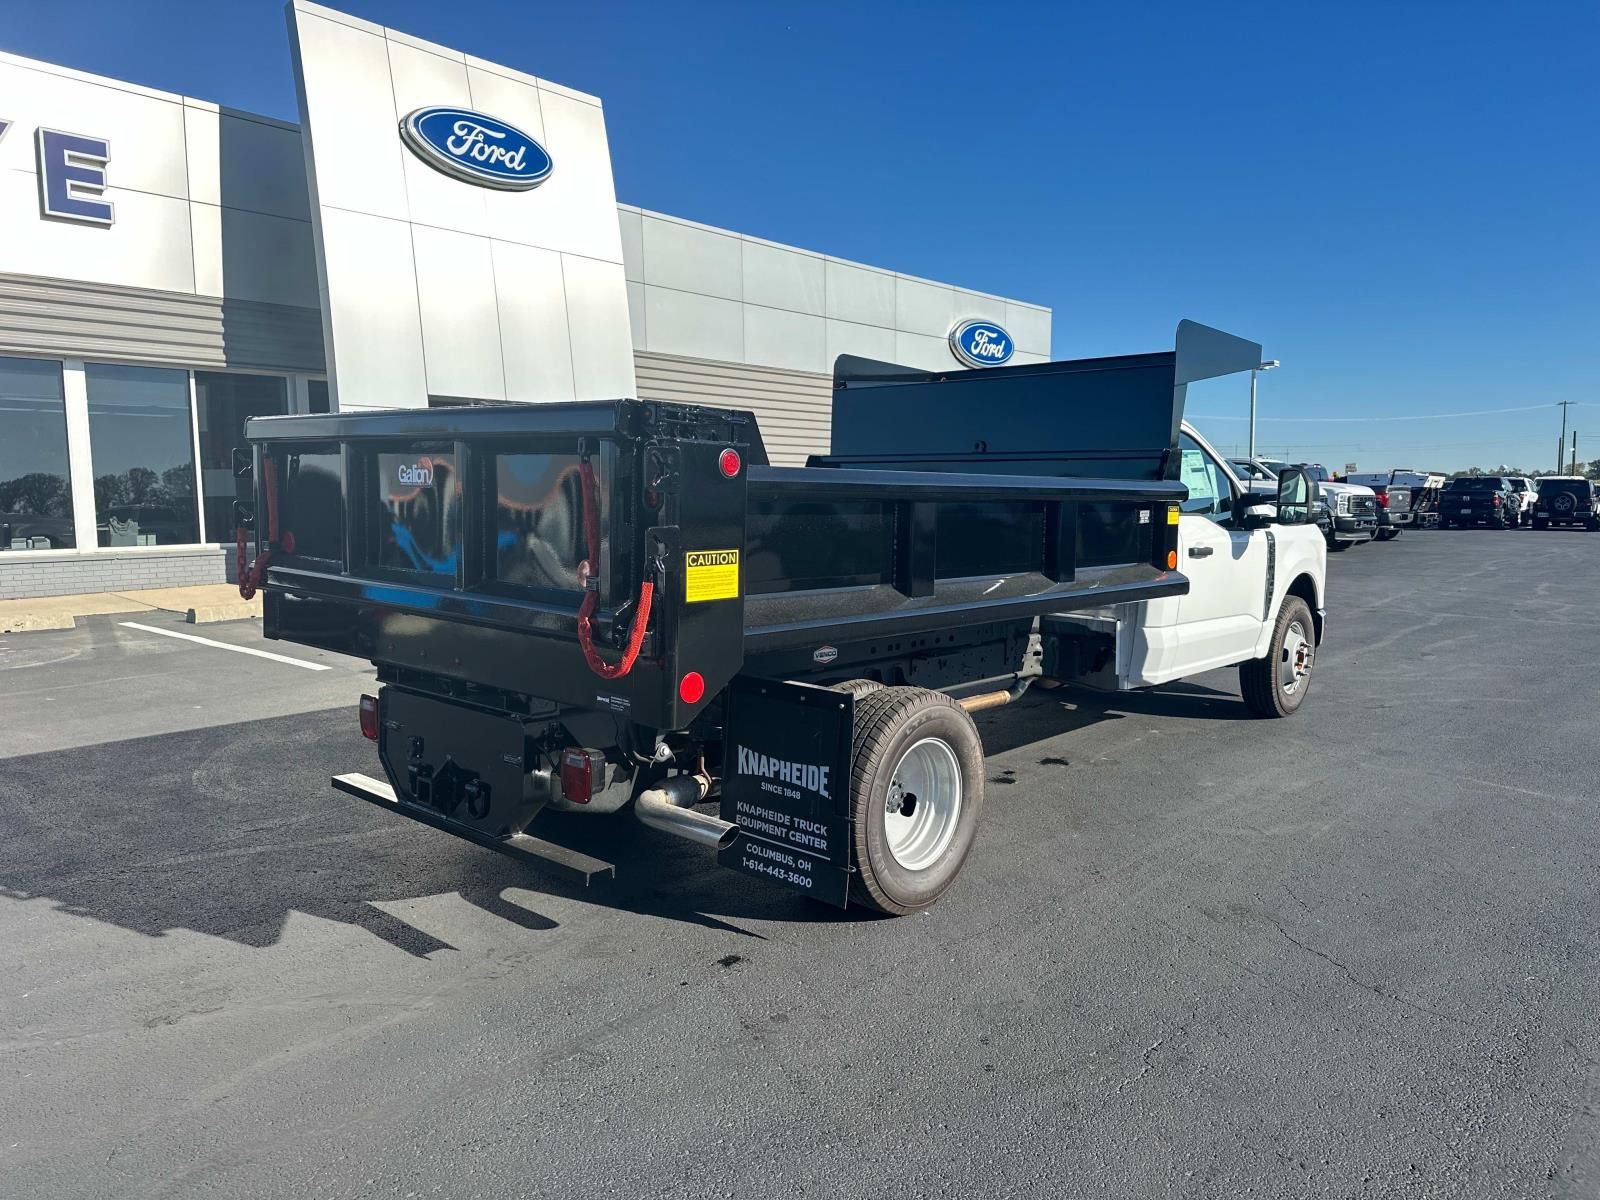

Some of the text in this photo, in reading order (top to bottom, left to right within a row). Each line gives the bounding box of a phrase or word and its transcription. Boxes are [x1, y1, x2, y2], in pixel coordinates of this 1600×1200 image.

[447, 120, 526, 171] Ford
[0, 118, 115, 230] E
[971, 329, 1005, 358] Ford
[399, 464, 430, 483] Galion
[689, 553, 736, 566] CAUTION
[738, 745, 830, 798] KNAPHEIDE
[761, 782, 801, 800] SINCE 1848
[736, 815, 827, 850] EQUIPMENT CENTER
[737, 801, 828, 837] KNAPHEIDE TRUCK
[742, 857, 812, 888] 1-614-443-3600
[746, 843, 812, 871] COLUMBUS, OH
